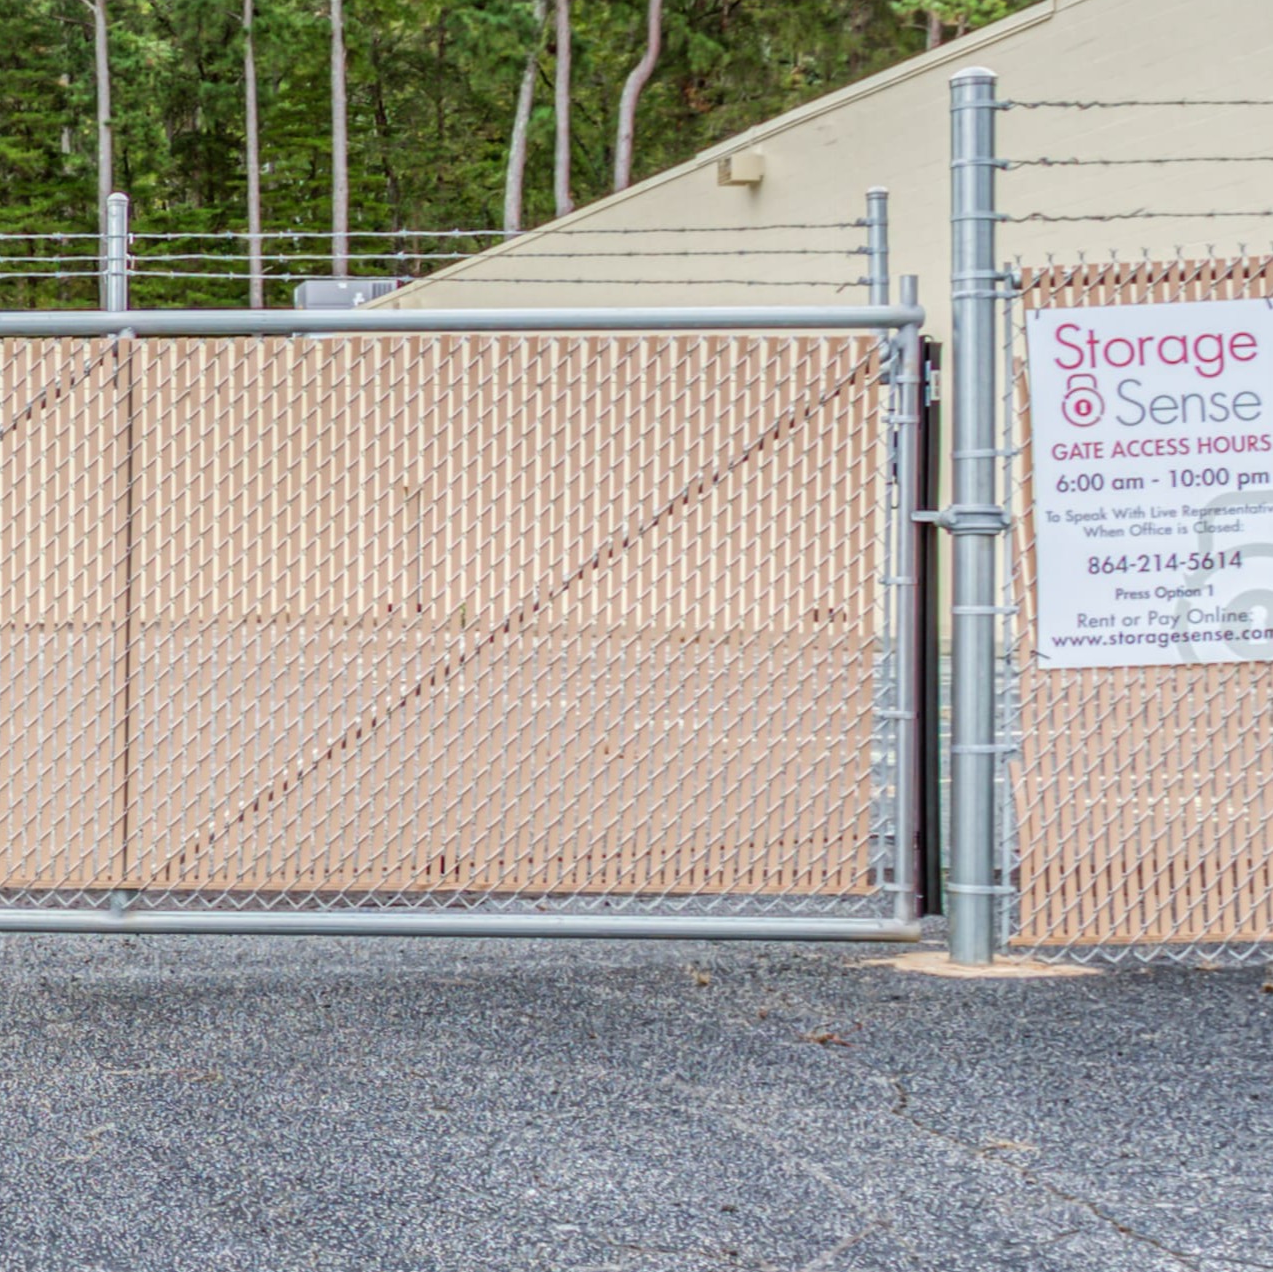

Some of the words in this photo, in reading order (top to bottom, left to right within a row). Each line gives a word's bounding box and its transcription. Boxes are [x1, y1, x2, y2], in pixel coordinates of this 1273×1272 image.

[1054, 323, 1258, 378] Storage
[1116, 378, 1262, 427] Sense
[1051, 441, 1104, 461] GATE
[1111, 438, 1190, 459] ACCESS
[1198, 434, 1272, 455] HOURS
[1056, 473, 1104, 493] 6:00
[1112, 476, 1144, 491] am
[1169, 467, 1230, 488] 10:00
[1237, 471, 1270, 491] pm
[1046, 510, 1060, 523] To
[1065, 506, 1107, 525] Speak
[1112, 506, 1145, 520] With
[1151, 506, 1177, 519] Live
[1083, 523, 1125, 538] When
[1129, 522, 1172, 537] Office
[1177, 522, 1188, 535] is
[1193, 519, 1245, 534] Closed:
[1088, 550, 1243, 575] 864-214-5614
[1115, 588, 1150, 601] Press
[1155, 586, 1201, 602] Option
[1206, 584, 1214, 597] 1
[1077, 613, 1116, 629] Rent
[1122, 614, 1141, 627] or
[1148, 609, 1181, 630] Pay
[1187, 605, 1254, 624] Online:
